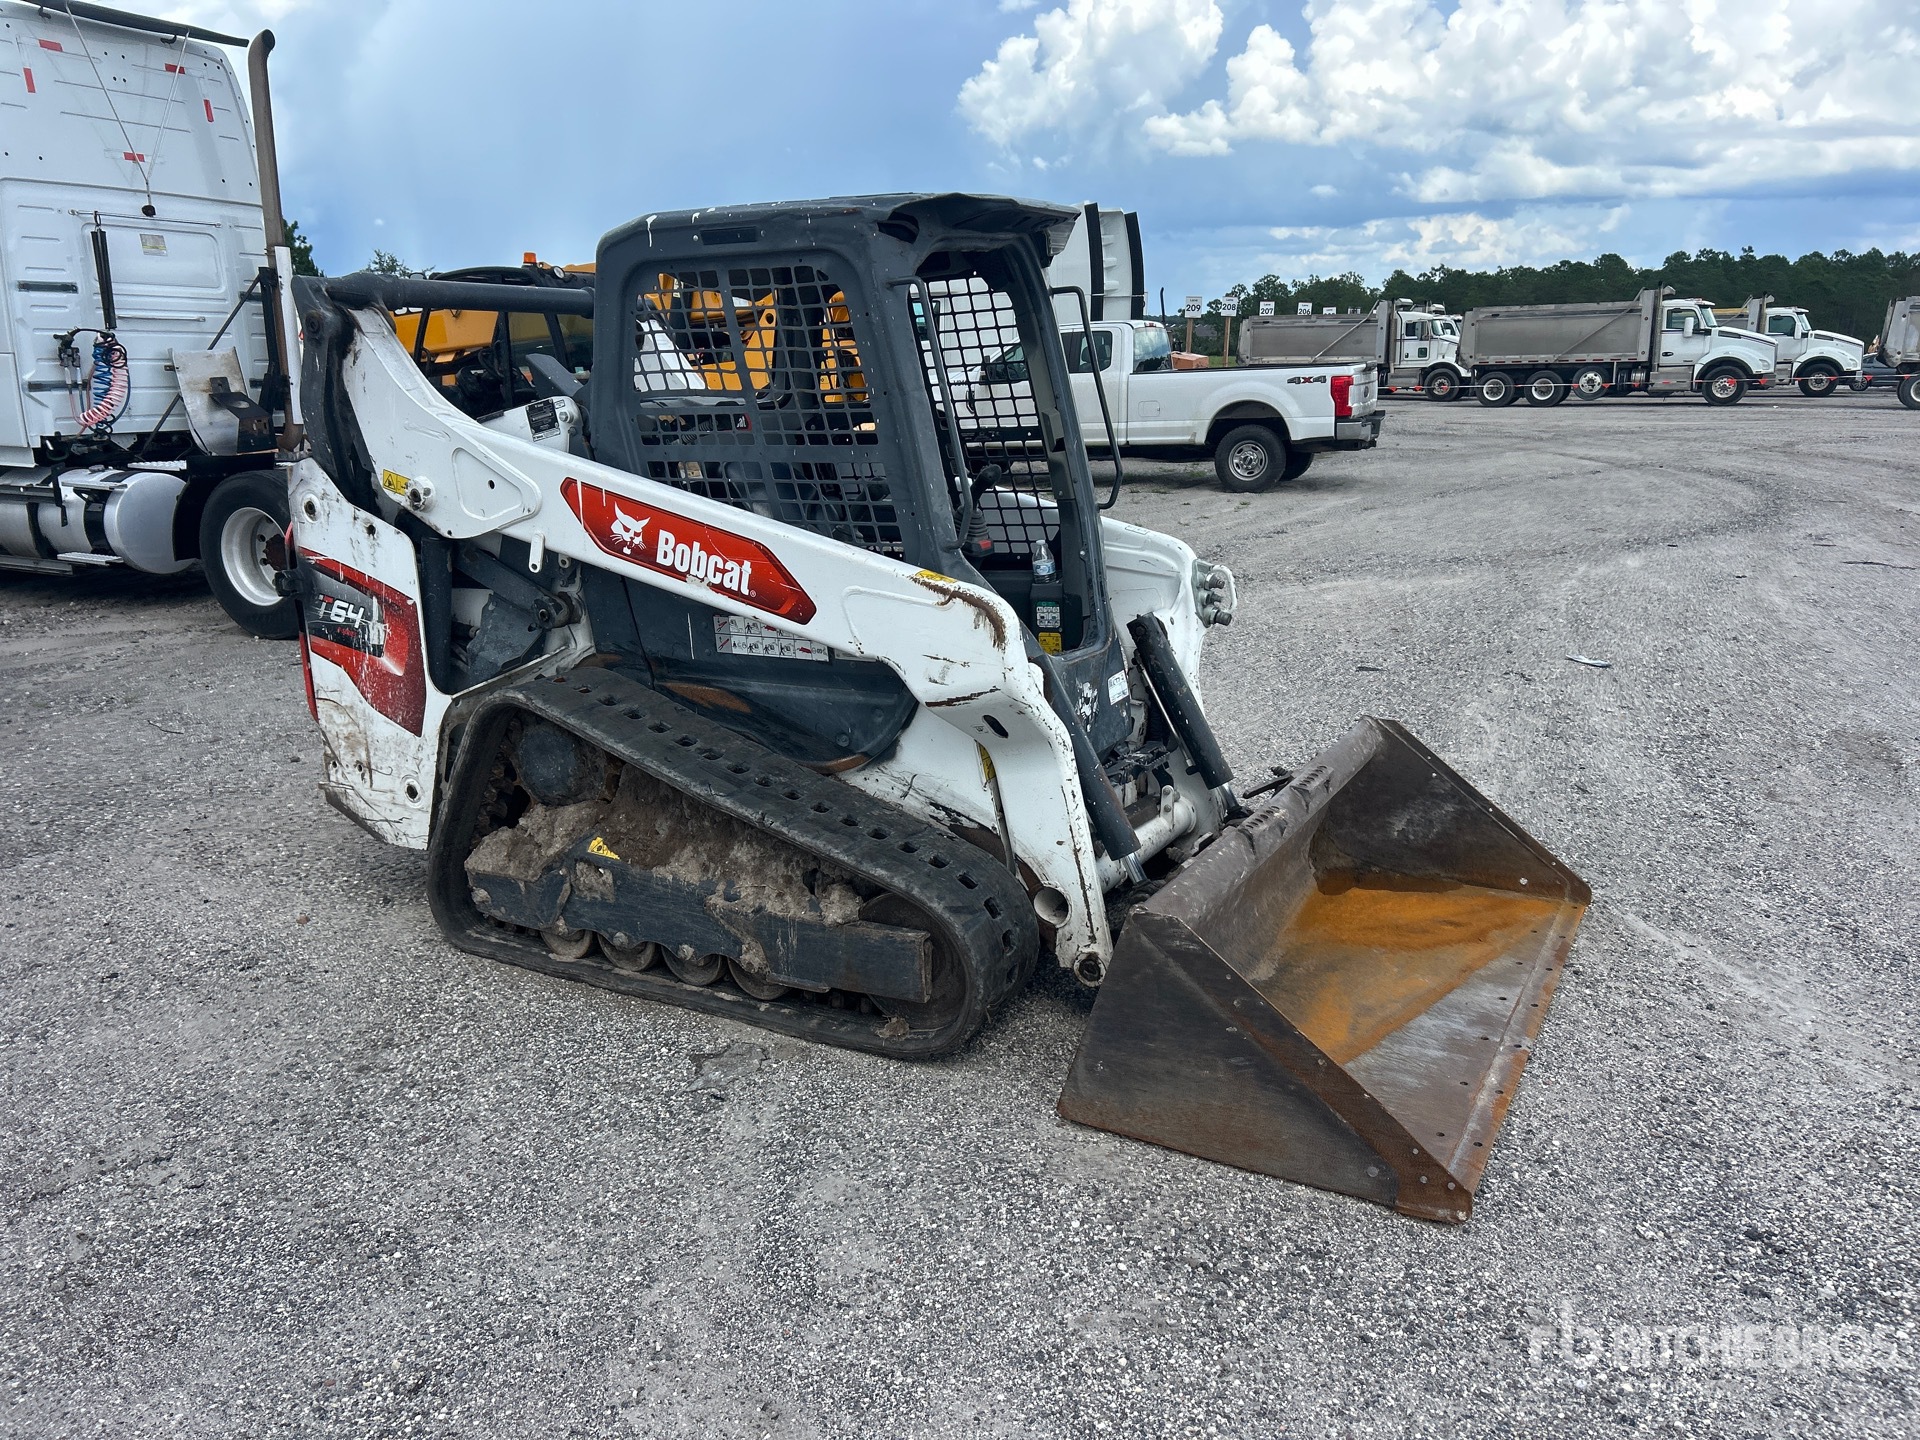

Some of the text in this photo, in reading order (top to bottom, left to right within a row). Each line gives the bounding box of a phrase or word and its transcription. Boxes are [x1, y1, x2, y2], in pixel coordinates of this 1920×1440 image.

[1186, 304, 1201, 312] 209
[1222, 303, 1237, 311] 208
[1260, 307, 1274, 315] 207
[1298, 308, 1311, 316] 206
[656, 529, 752, 596] Bobcat
[317, 592, 365, 629] T64
